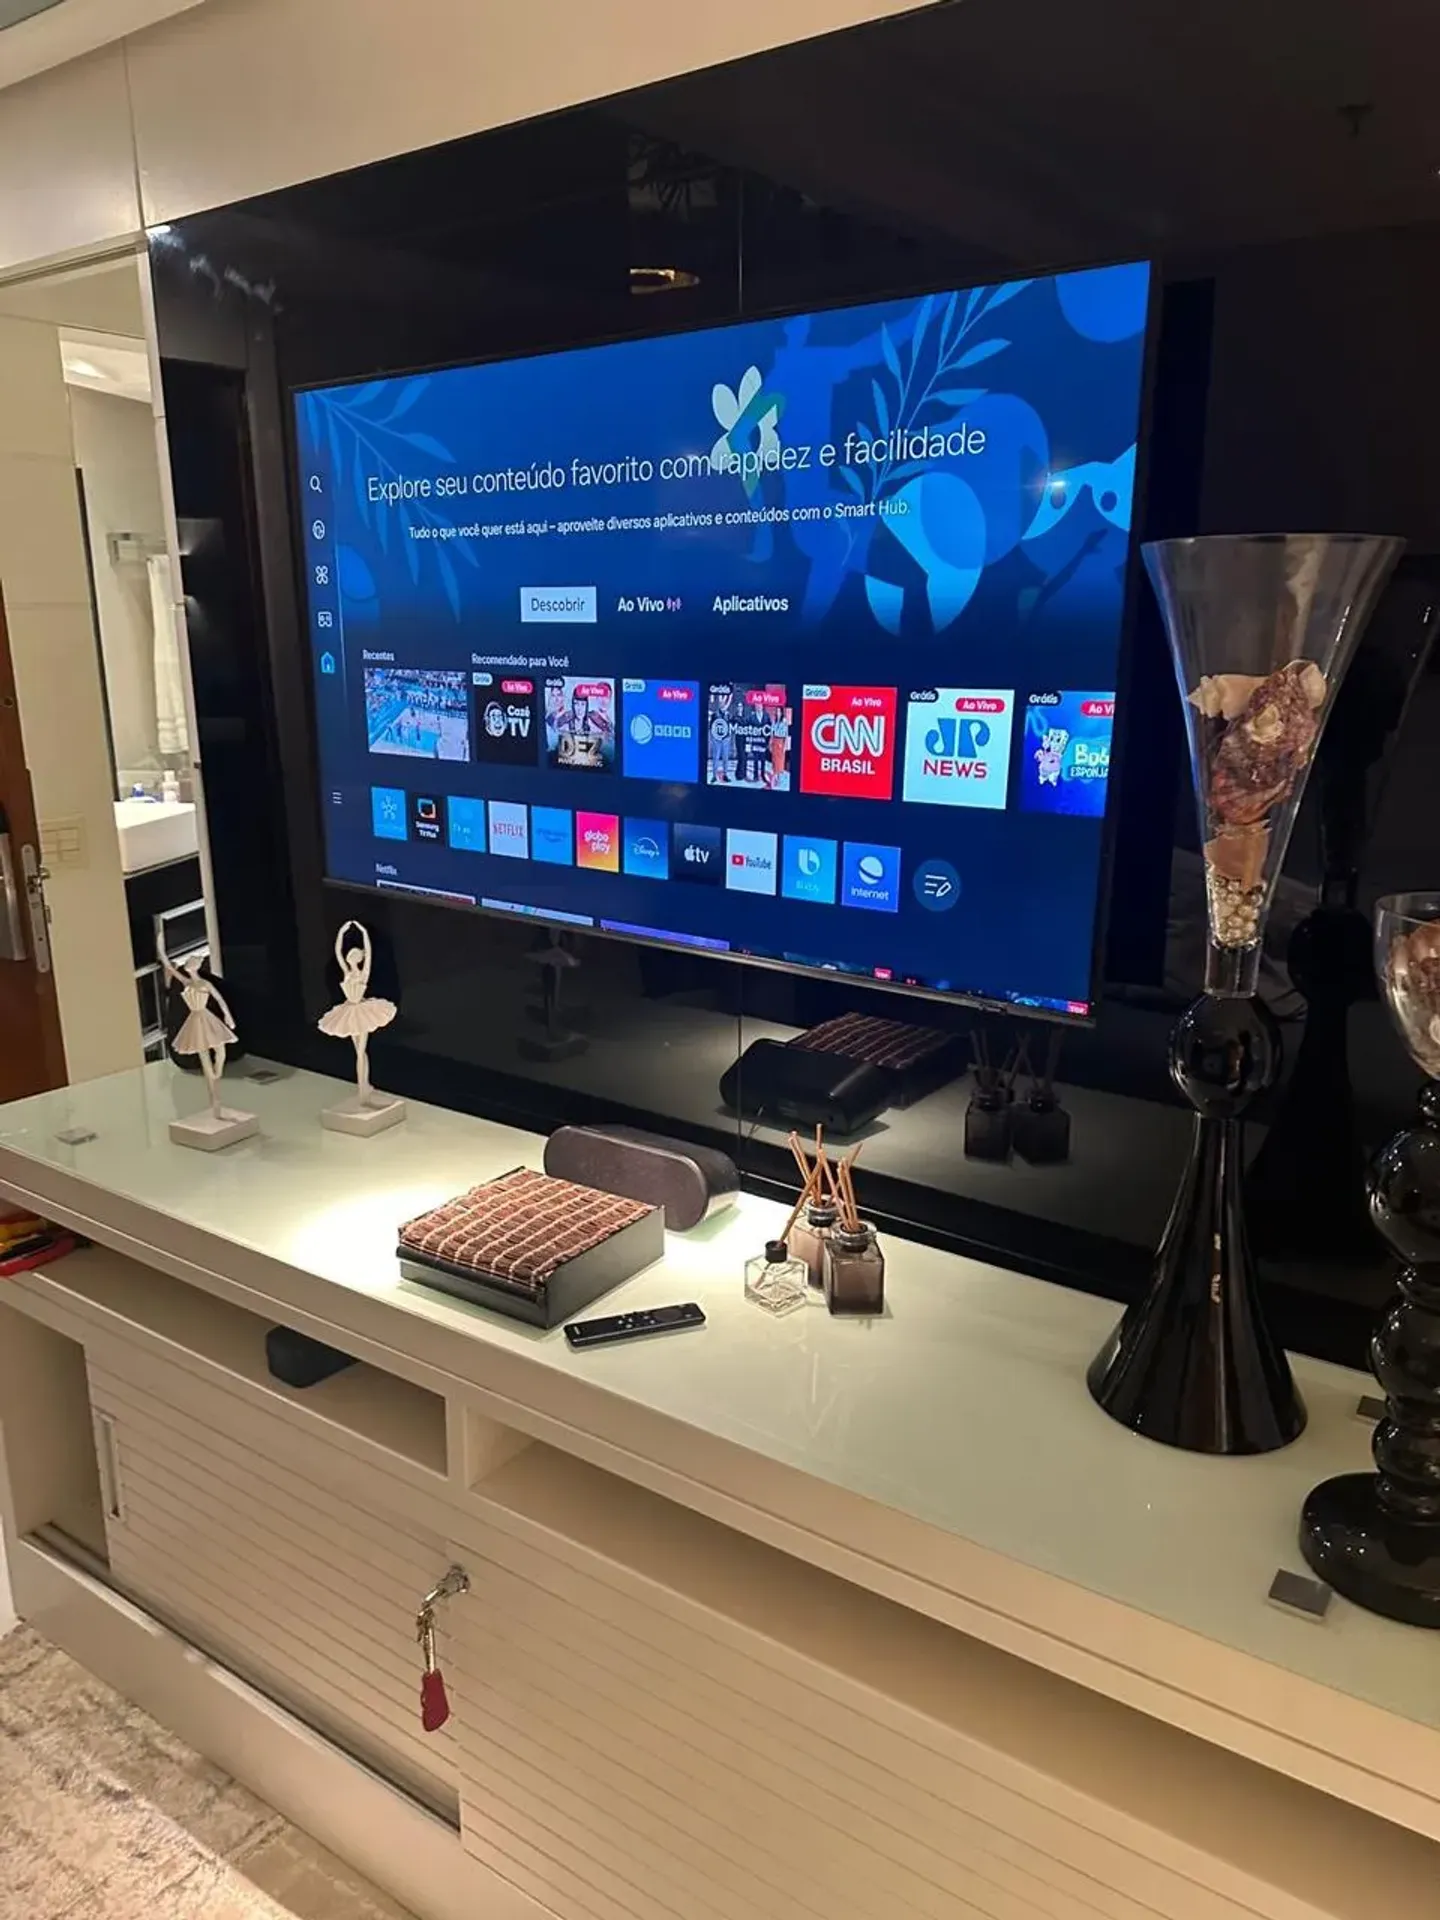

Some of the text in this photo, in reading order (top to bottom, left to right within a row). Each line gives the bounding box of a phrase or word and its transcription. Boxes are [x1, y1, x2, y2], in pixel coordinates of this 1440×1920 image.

[367, 422, 986, 506] Explore seu conteúdo favorito com rapidez e facilidade
[409, 526, 431, 539] Tudo
[432, 529, 438, 539] o
[439, 529, 456, 541] que
[458, 522, 480, 536] você
[481, 525, 502, 538] quer
[505, 520, 526, 535] está
[527, 519, 548, 536] aqui
[557, 518, 605, 535] aproveite
[606, 515, 651, 531] diversos
[653, 511, 712, 531] aplicativos
[715, 513, 723, 526] e
[725, 505, 790, 525] conteúdos
[792, 508, 820, 521] com
[823, 506, 832, 519] o
[835, 502, 875, 519] Smart
[530, 597, 585, 612] Descobrir
[617, 596, 664, 612] Ao Vivo
[712, 595, 789, 615] Aplicativos
[362, 650, 395, 662] Recentes
[471, 653, 569, 668] Recomendado para Você
[752, 694, 780, 704] Ao Vivo
[851, 697, 882, 707] Ao Vivo
[910, 690, 936, 701] Grátis
[1029, 693, 1058, 704] Grátis
[507, 704, 531, 718] Cazé
[962, 700, 997, 711] Ao Vivo
[1088, 703, 1102, 714] Ao
[507, 718, 531, 738] TV
[729, 722, 788, 737] MasterC
[811, 713, 885, 757] CNN
[559, 733, 601, 759] DEZ
[821, 757, 876, 775] BRASIL
[923, 759, 988, 779] NEWS
[584, 829, 610, 843] globo
[591, 840, 611, 855] play
[695, 847, 710, 864] tv
[375, 863, 398, 876] Netflix
